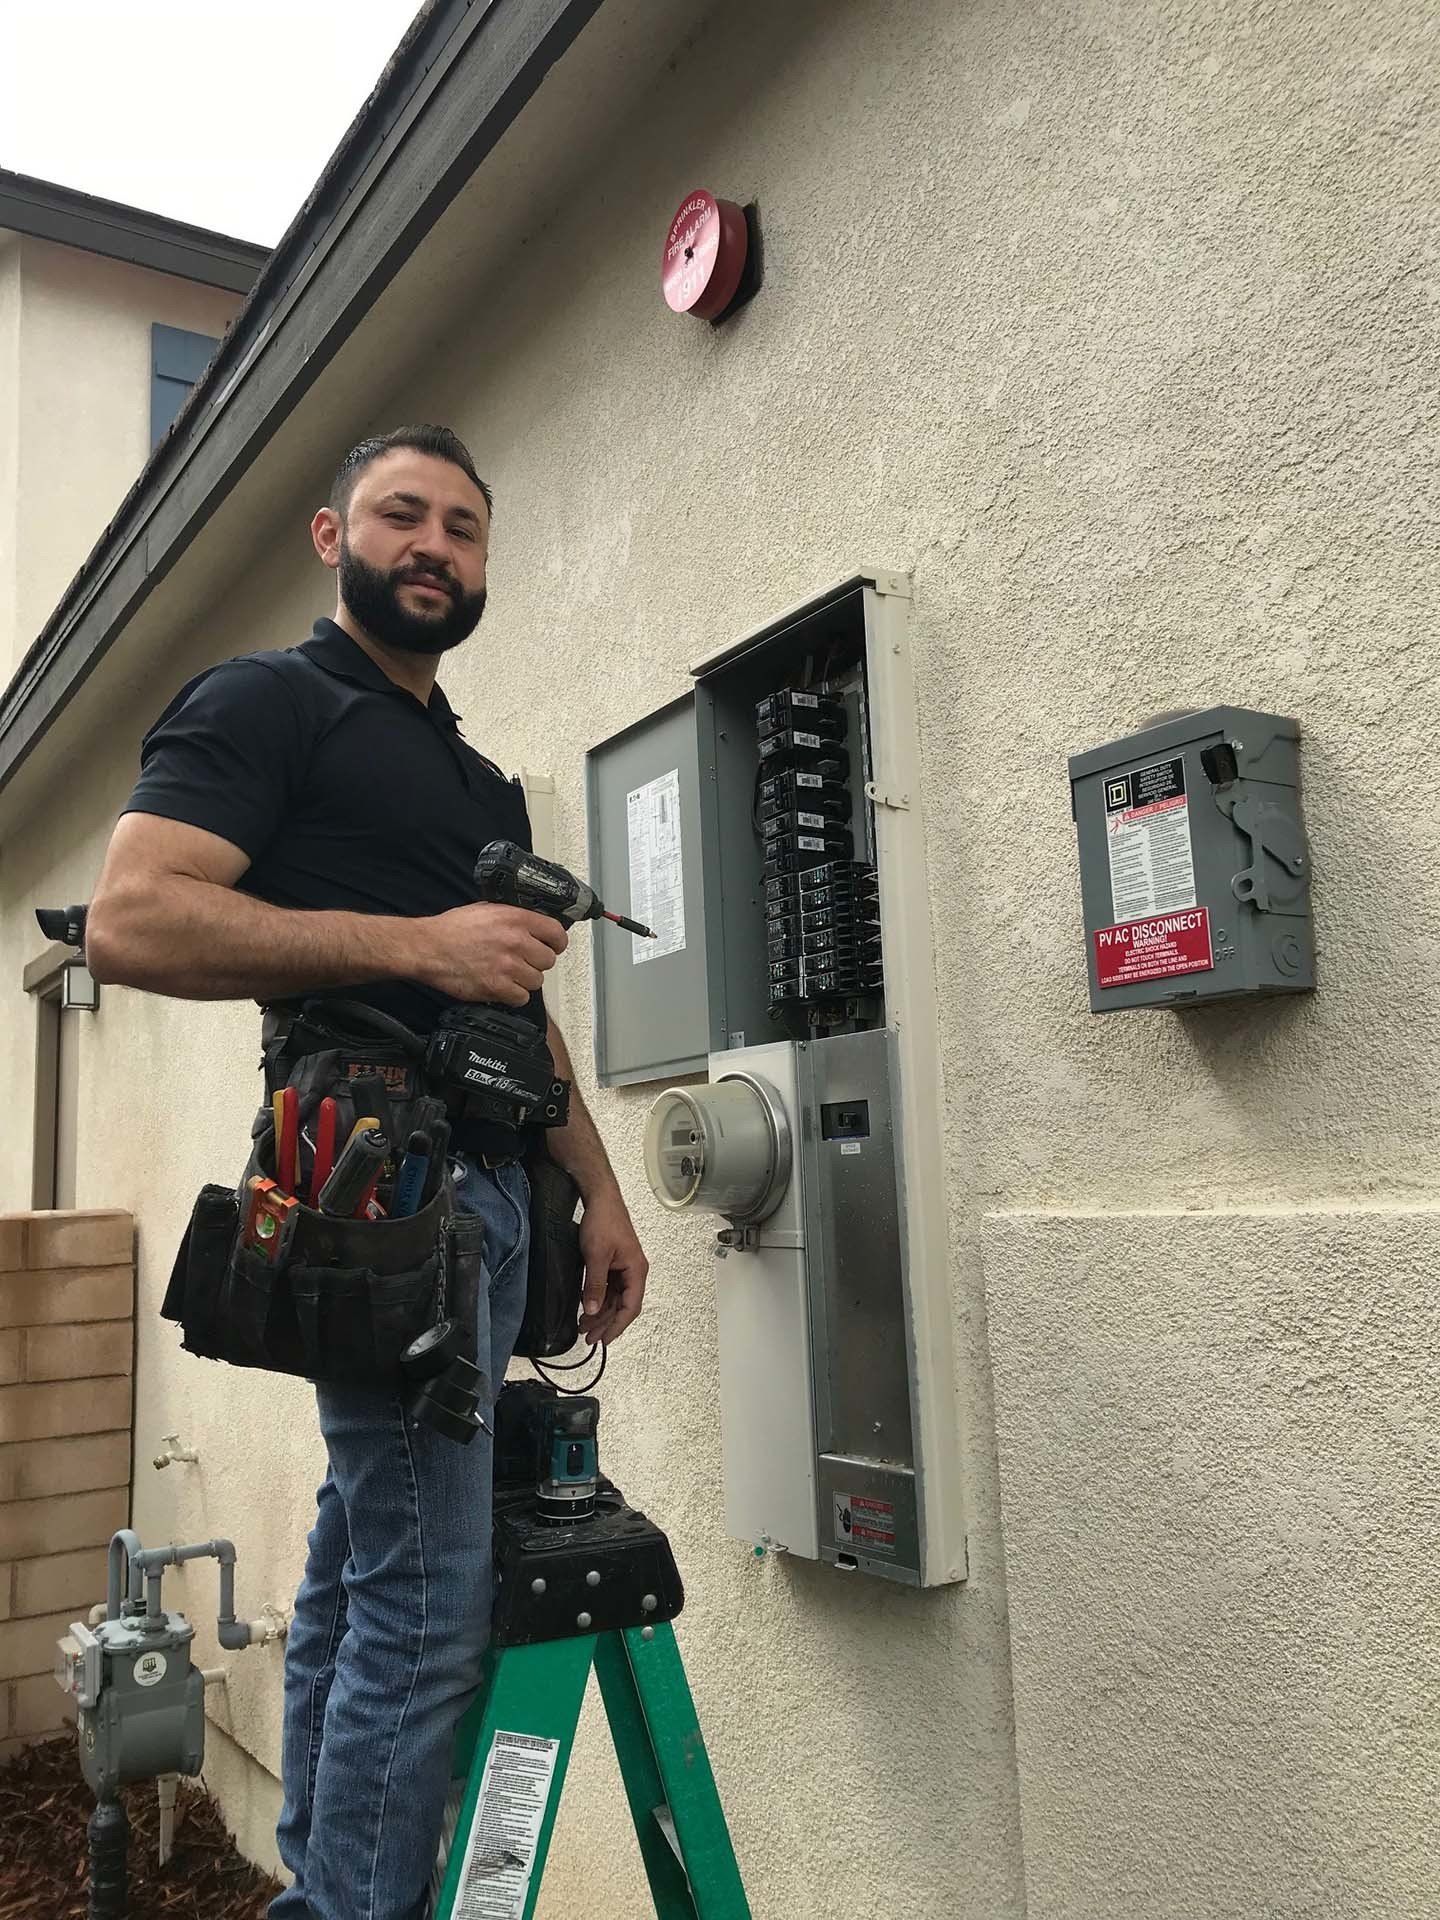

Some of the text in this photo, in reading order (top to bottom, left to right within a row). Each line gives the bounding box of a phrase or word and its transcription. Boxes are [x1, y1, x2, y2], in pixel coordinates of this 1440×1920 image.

[670, 199, 706, 243] SPRINKLER
[667, 206, 712, 261] FIRE ALARM
[1099, 912, 1203, 947] PV AC DISCONNECT
[1125, 942, 1177, 957] ELECTRIC SHOCK HAZARD
[1133, 935, 1167, 949] WARNING!
[1140, 954, 1154, 962] TOUCH
[1215, 945, 1235, 960] OFF
[1101, 976, 1112, 984] LOAD
[1176, 962, 1188, 970] OPEN
[1188, 959, 1209, 968] POSITION
[1118, 964, 1140, 973] TERMINALS
[1148, 960, 1159, 968] BOTH
[1168, 956, 1178, 964] LINE
[1178, 954, 1187, 962] AND
